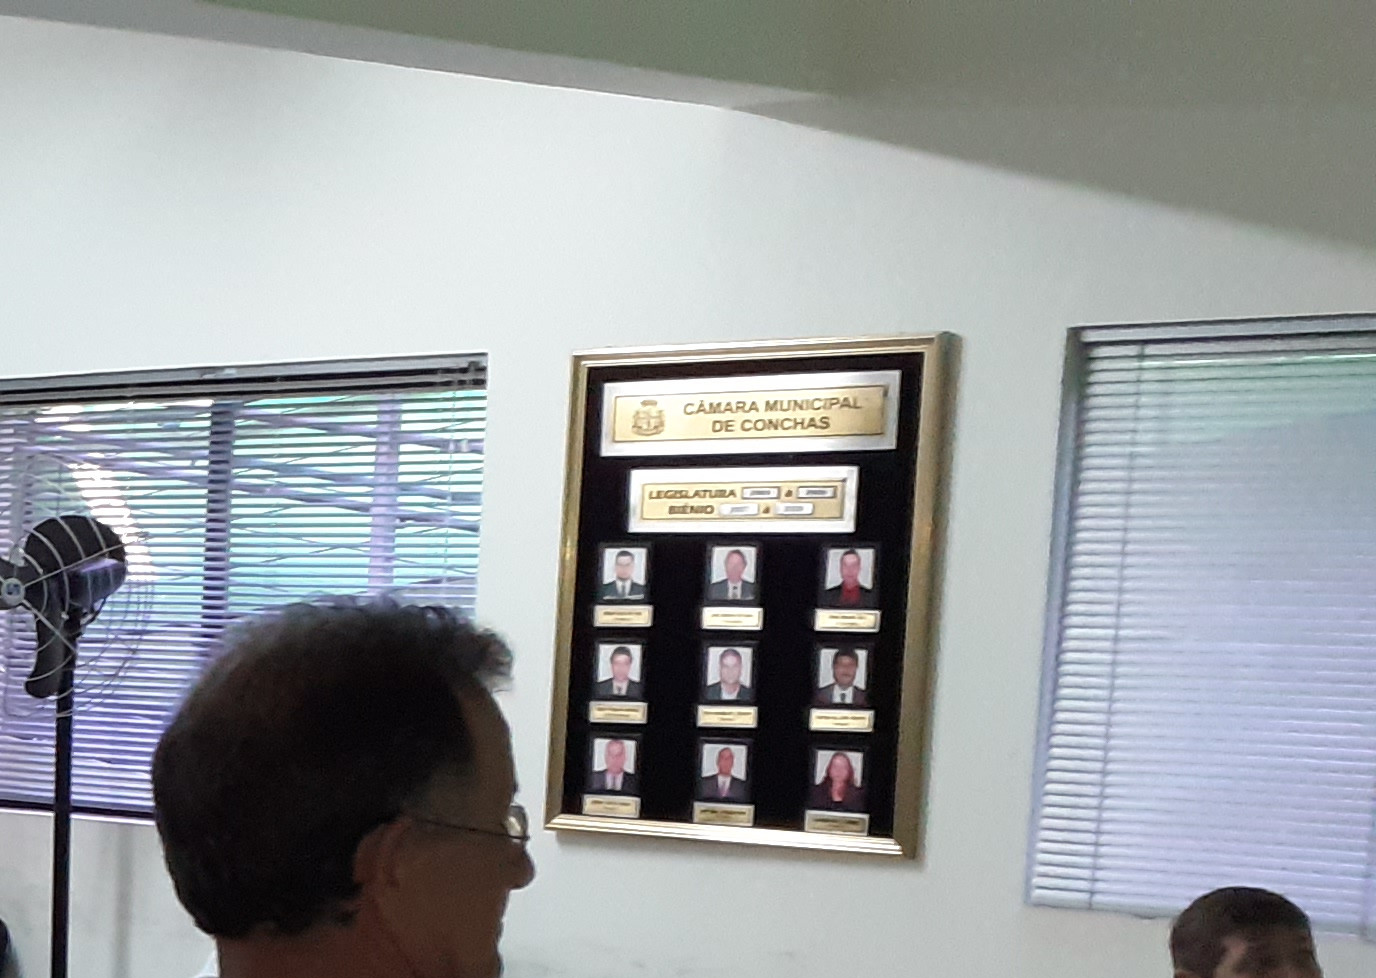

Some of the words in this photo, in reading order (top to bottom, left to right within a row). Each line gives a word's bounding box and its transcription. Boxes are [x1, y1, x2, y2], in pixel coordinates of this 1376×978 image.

[683, 400, 759, 415] CÂMARA
[764, 397, 863, 413] MUNICIPAL
[711, 419, 736, 433] DE
[740, 416, 831, 432] CONCHAS
[649, 489, 737, 499] LEGISLATURA
